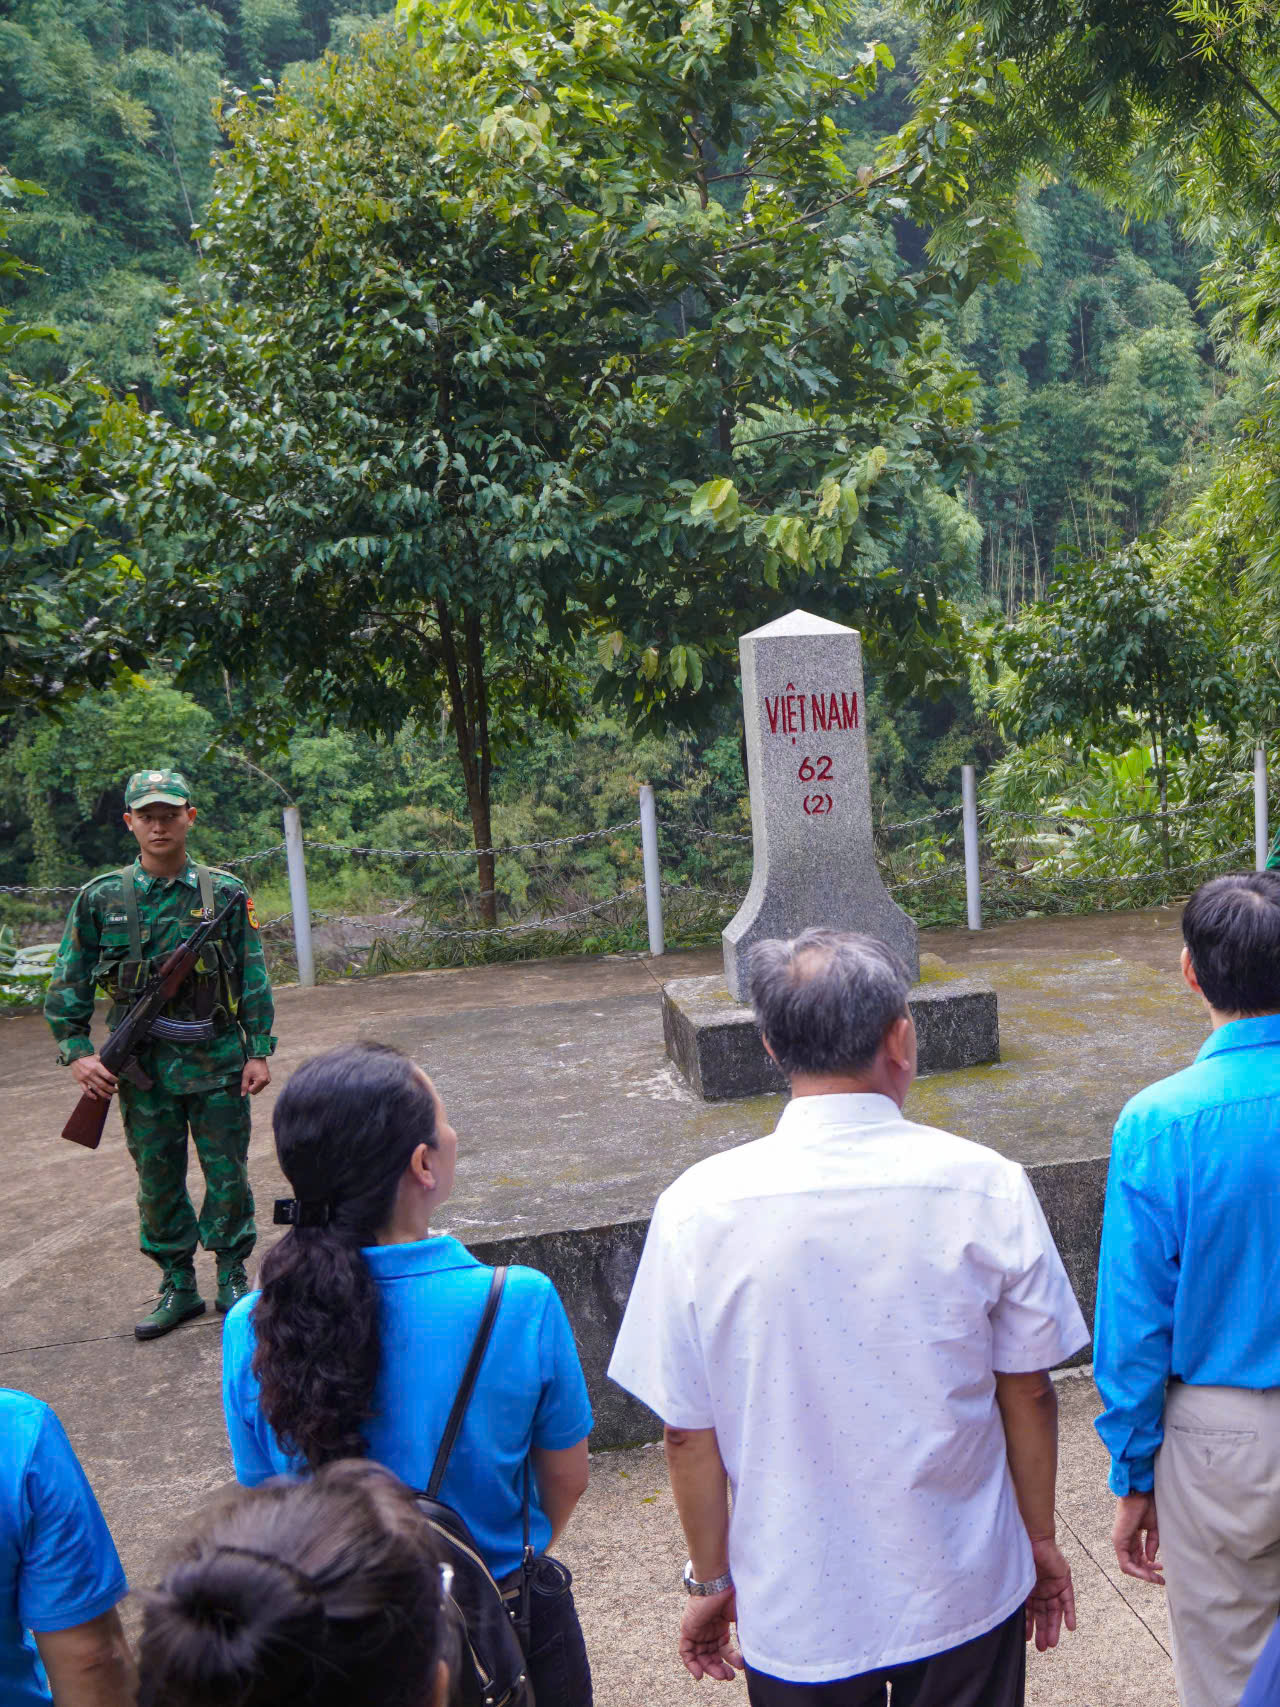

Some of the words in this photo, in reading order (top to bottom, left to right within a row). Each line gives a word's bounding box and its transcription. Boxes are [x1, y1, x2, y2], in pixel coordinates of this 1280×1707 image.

[765, 682, 806, 745] VIỆT
[811, 691, 859, 731] NAM
[798, 755, 834, 782] 62
[803, 793, 833, 815] (2)
